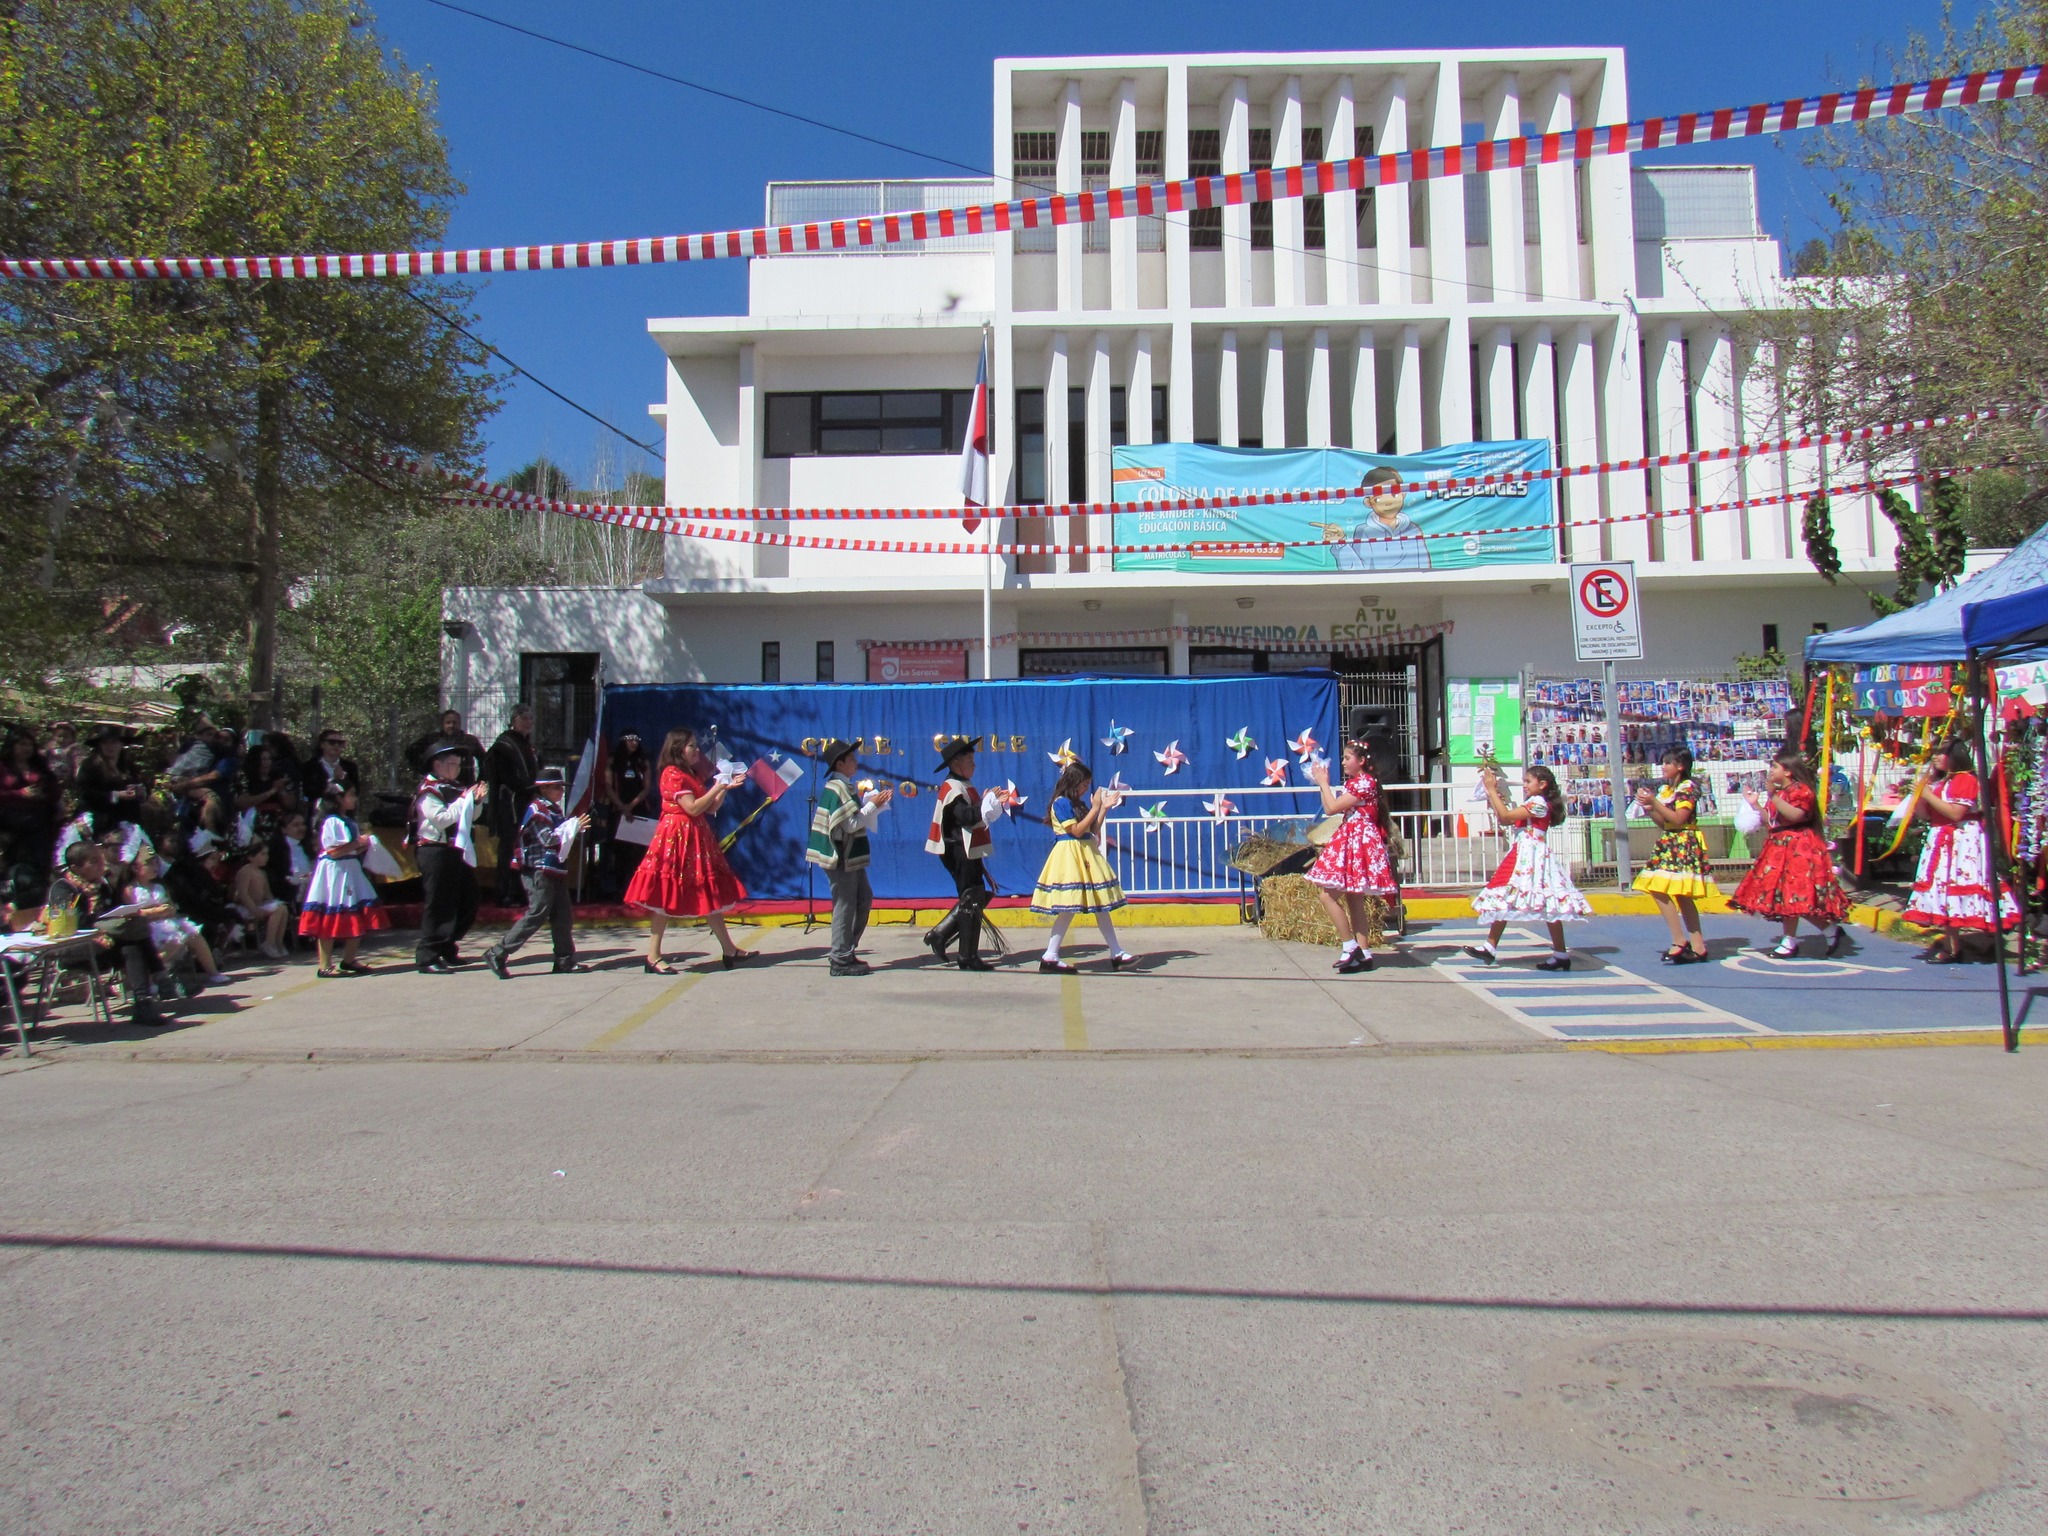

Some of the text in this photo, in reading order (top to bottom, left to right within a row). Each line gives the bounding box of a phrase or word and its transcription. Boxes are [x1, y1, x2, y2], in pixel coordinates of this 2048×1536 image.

[1138, 519, 1228, 534] EDUCACIÓN BÁSICA
[1595, 578, 1614, 607] E
[1355, 608, 1397, 622] A TU
[1330, 623, 1421, 641] ESCUE
